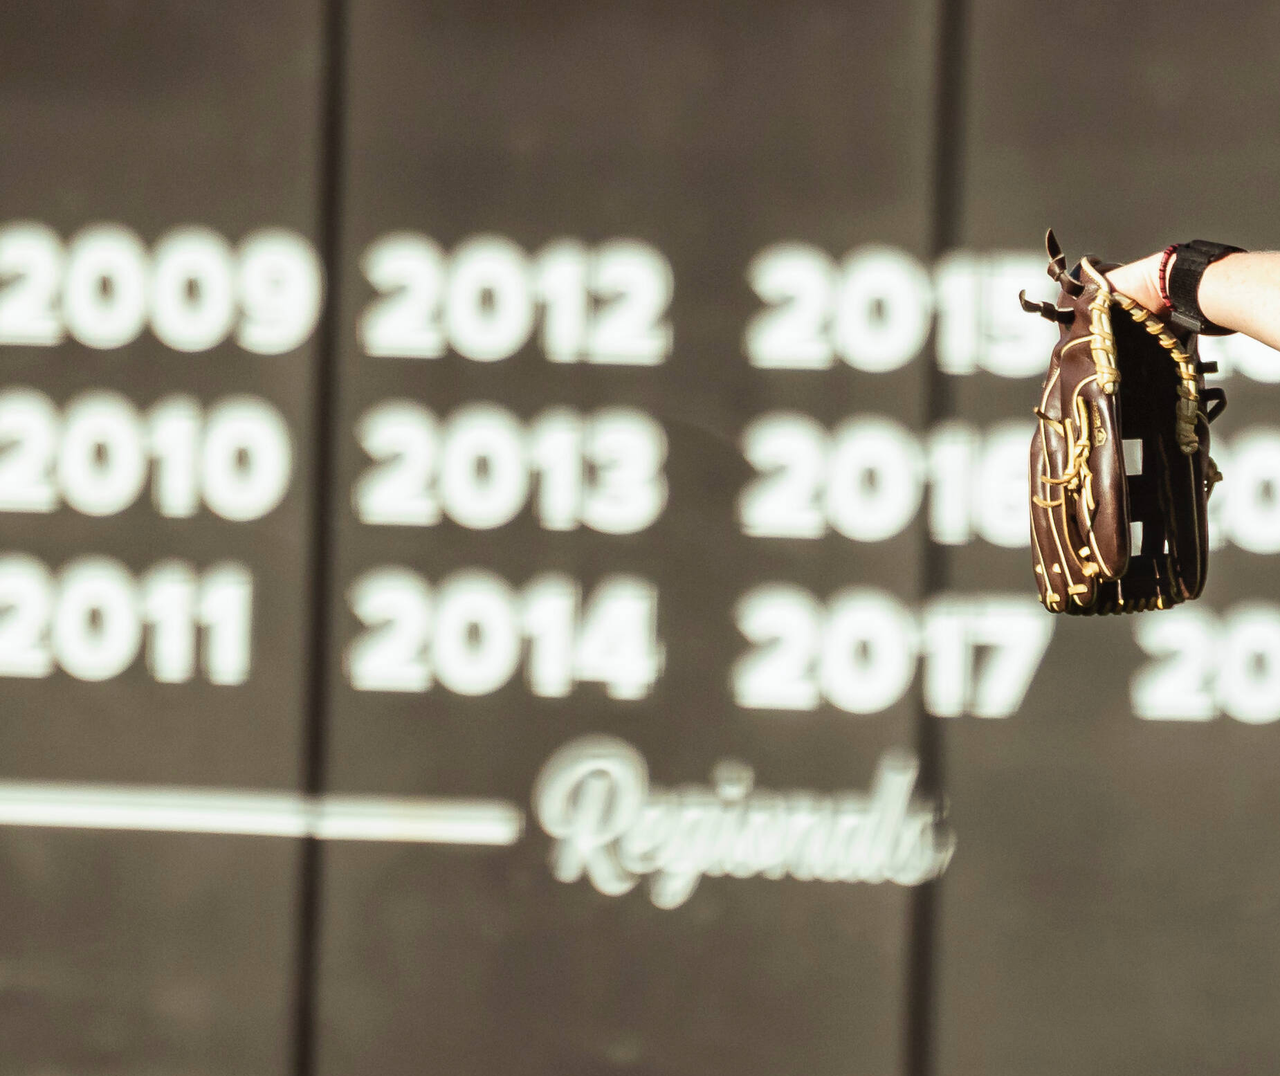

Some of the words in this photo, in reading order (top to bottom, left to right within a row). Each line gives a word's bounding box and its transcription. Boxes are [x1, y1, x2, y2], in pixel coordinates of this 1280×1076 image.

[0, 226, 323, 355] 2009
[361, 233, 673, 366] 2012
[747, 242, 1060, 379] 2015
[0, 390, 293, 522] 2010
[357, 403, 668, 535] 2013
[0, 554, 253, 685] 2011
[349, 568, 665, 700] 2014
[733, 582, 1055, 718] 2017
[534, 735, 957, 910] Regionals
